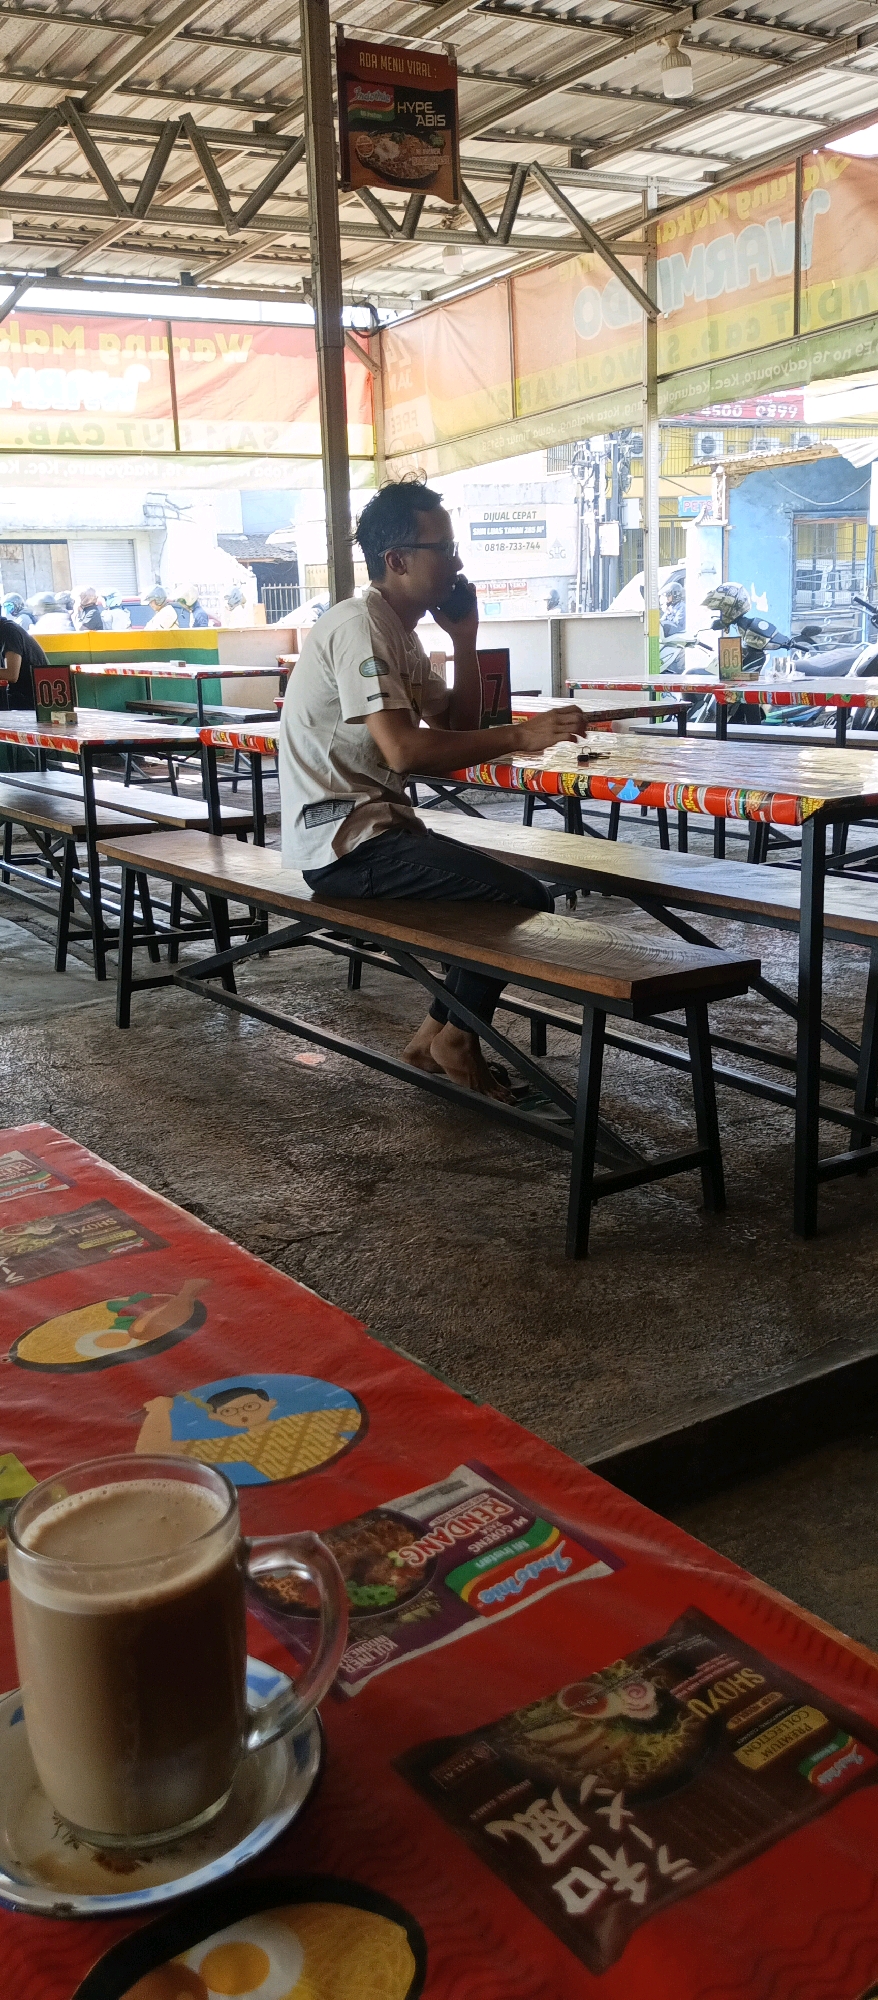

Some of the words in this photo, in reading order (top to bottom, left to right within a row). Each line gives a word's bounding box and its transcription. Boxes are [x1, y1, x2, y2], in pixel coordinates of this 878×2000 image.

[360, 52, 377, 69] ADA
[380, 55, 404, 73] MENU
[407, 60, 431, 78] VIRAL
[397, 102, 435, 114] HYPE
[415, 114, 446, 127] ABIS
[483, 511, 510, 522] DIJUAL
[512, 511, 537, 520] CEPAT
[484, 541, 541, 552] 0818-733-744
[38, 678, 70, 709] 03
[399, 1497, 515, 1568] RENDANG
[510, 1515, 529, 1530] MI
[467, 1524, 515, 1553] GORENG
[477, 1540, 573, 1605] Indomie
[346, 1640, 398, 1674] KULINER
[686, 1668, 766, 1719] SHOYU
[743, 1709, 810, 1756] COLLECTION
[764, 1722, 814, 1759] PREMIUM
